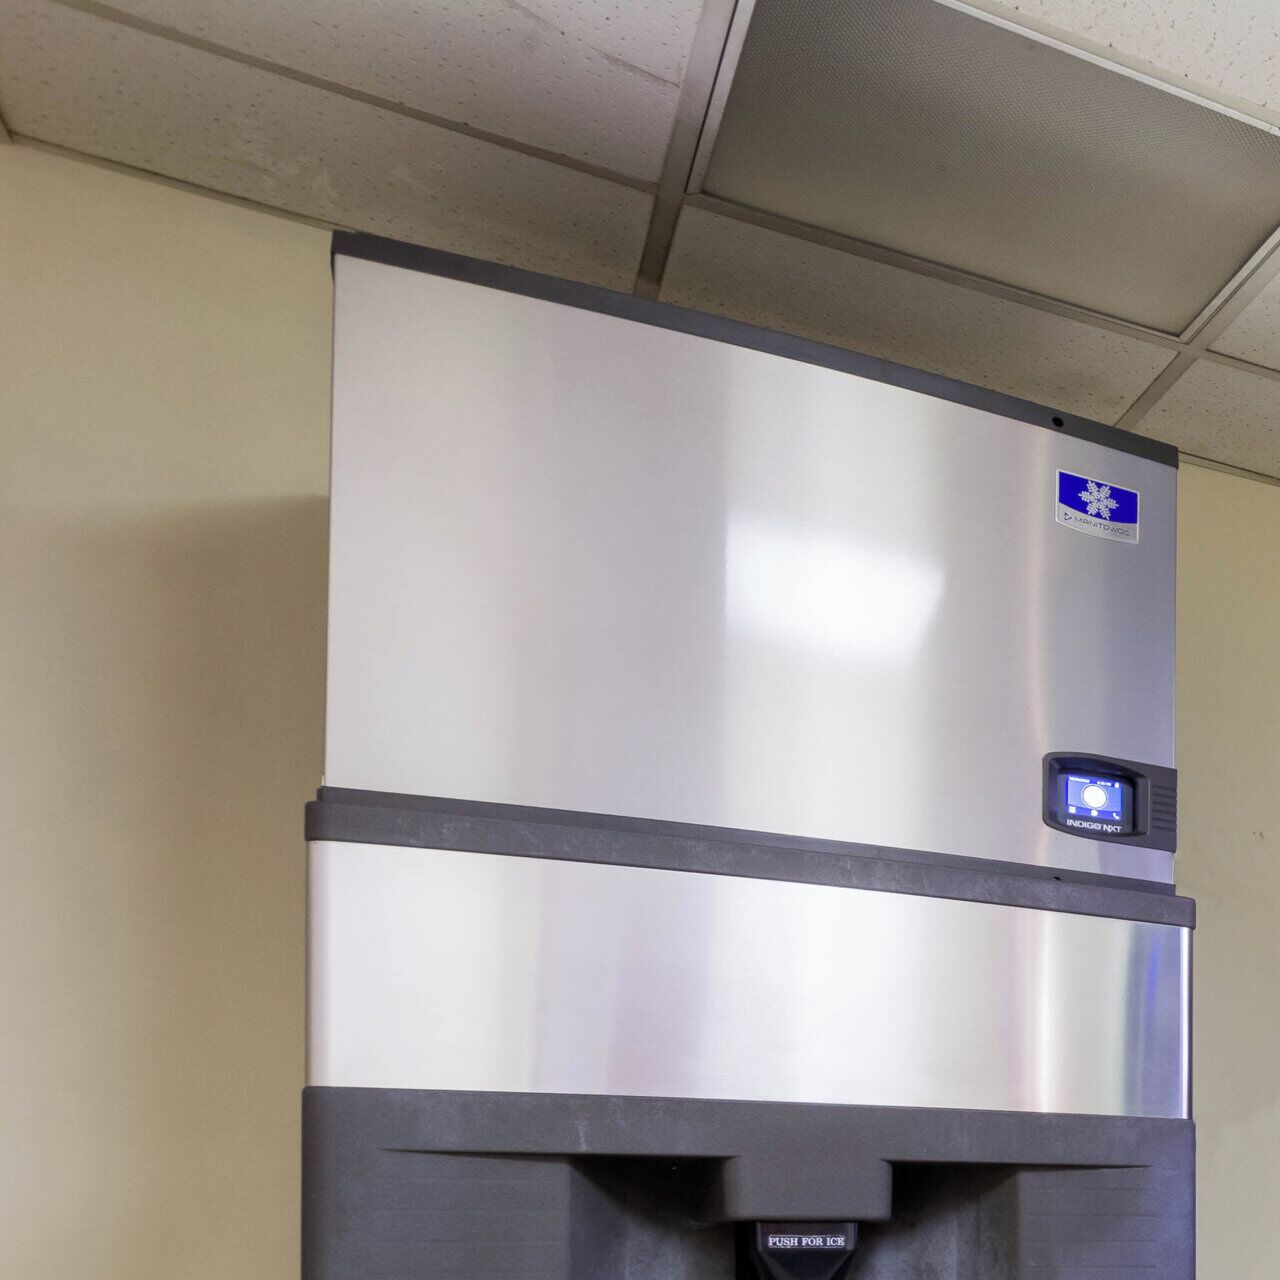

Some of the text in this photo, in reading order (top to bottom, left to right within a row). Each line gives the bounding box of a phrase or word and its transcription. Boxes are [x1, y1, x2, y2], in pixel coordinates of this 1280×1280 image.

[1074, 516, 1131, 537] MANITOWOC
[1066, 818, 1123, 834] INDIGO NXT
[769, 1236, 845, 1247] PUSH FOR ICE
